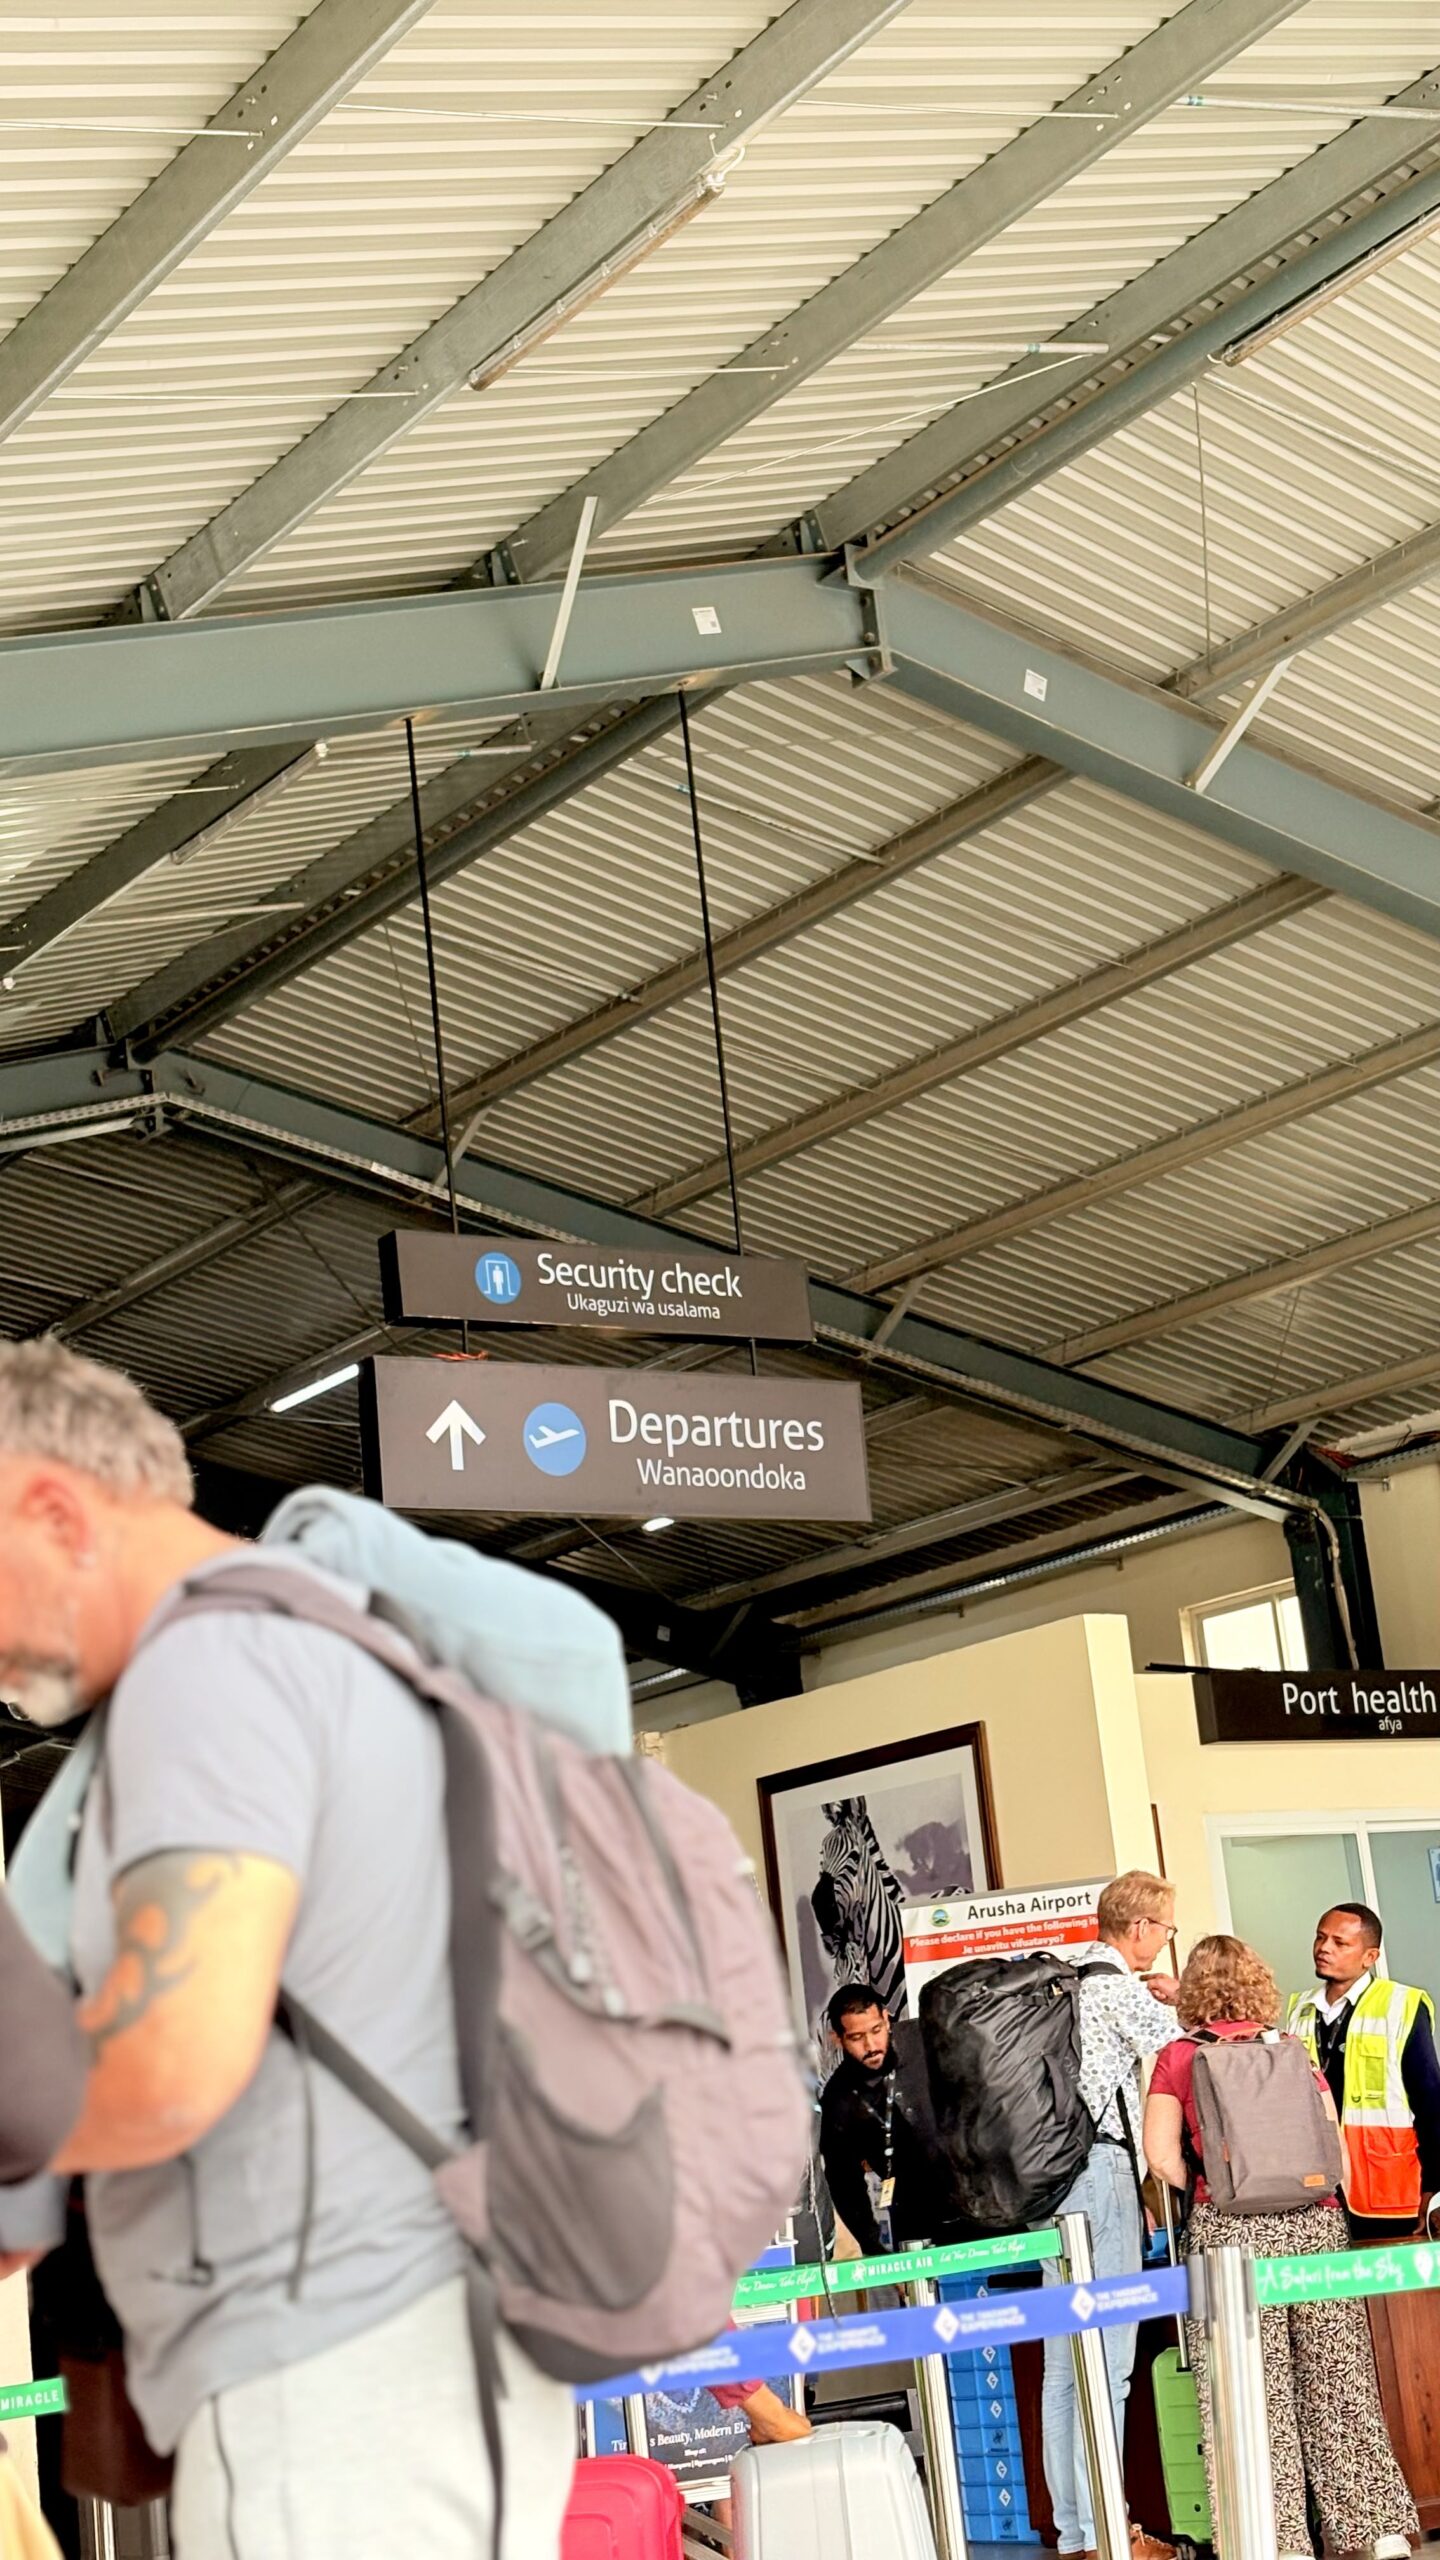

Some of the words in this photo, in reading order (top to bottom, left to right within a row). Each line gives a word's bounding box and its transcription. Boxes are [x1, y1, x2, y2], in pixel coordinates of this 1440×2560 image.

[536, 1252, 655, 1300] Security
[660, 1262, 743, 1298] check
[566, 1293, 630, 1317] Ukaguzi
[632, 1301, 655, 1316] wa
[657, 1299, 721, 1320] usalama
[608, 1399, 825, 1458] Departures
[636, 1458, 807, 1491] Wanaoondoka
[1282, 1681, 1341, 1715] Port
[1350, 1680, 1438, 1714] health
[1378, 1715, 1403, 1735] afya
[966, 1898, 1026, 1920] Arusha
[1029, 1890, 1092, 1914] Airport
[910, 1936, 940, 1948] Please
[941, 1932, 975, 1944] declare
[976, 1929, 983, 1939] if
[984, 1928, 1001, 1941] you
[1002, 1925, 1025, 1937] have
[1026, 1922, 1042, 1934] the
[1043, 1918, 1088, 1932] following
[962, 1944, 973, 1955] Je
[867, 2258, 912, 2277] MIRACLE
[915, 2255, 934, 2269] AIR
[1258, 2263, 1278, 2297] A
[1280, 2264, 1323, 2293] Safari
[1324, 2264, 1351, 2290] from
[1352, 2255, 1373, 2280] the
[1375, 2250, 1406, 2288] Sky
[0, 2389, 60, 2411] MIRACLE
[657, 2431, 693, 2446] Beauty,
[694, 2425, 732, 2440] Modern
